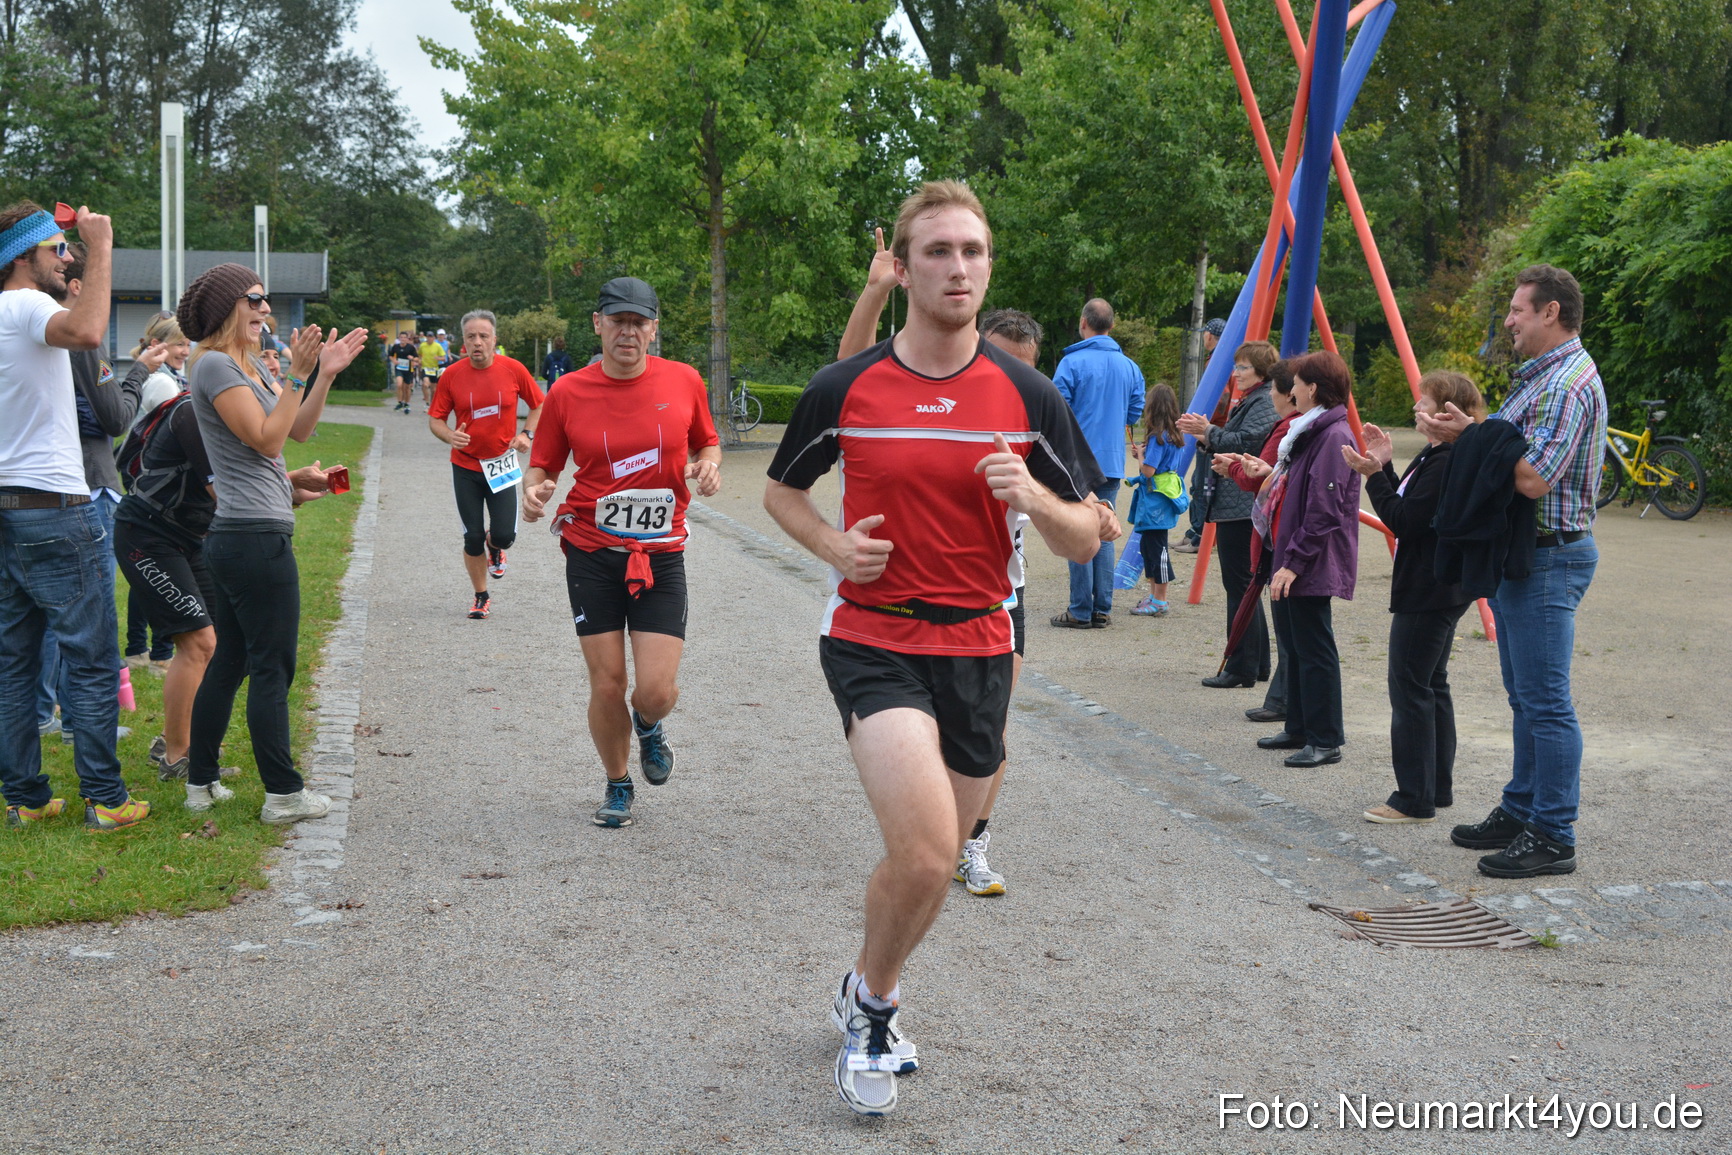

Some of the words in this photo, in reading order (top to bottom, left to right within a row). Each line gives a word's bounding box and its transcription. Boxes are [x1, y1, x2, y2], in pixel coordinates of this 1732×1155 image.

[916, 405, 945, 413] JAKO
[487, 454, 515, 477] 2747
[625, 457, 646, 470] DEHN
[0, 495, 20, 508] MA
[603, 502, 667, 530] 2143
[129, 548, 205, 617] skinfi
[901, 607, 914, 615] Day
